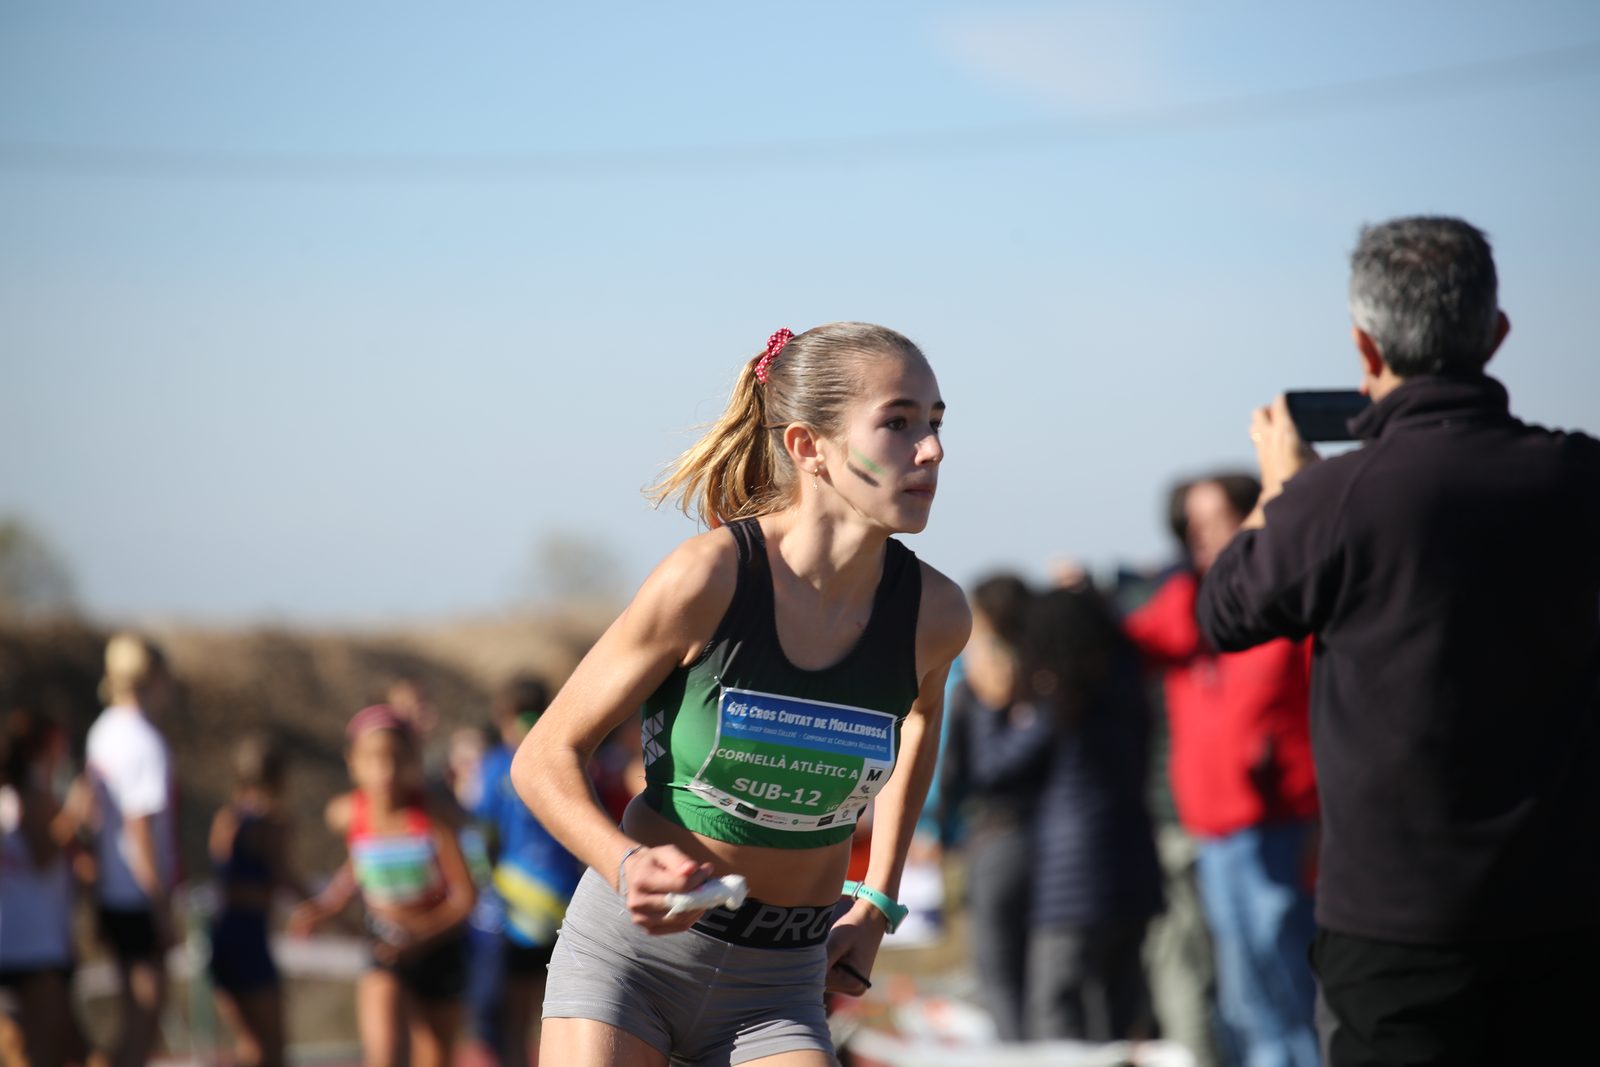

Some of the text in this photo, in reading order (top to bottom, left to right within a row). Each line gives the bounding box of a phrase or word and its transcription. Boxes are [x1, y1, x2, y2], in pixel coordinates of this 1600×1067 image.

[749, 706, 777, 721] CROS
[778, 710, 814, 727] CIUTAT
[813, 718, 828, 729] DE
[828, 718, 887, 740] MOLLERUSSA
[716, 748, 859, 780] CORNELLÀ ATLÈTIC A
[731, 777, 822, 807] SUB-12
